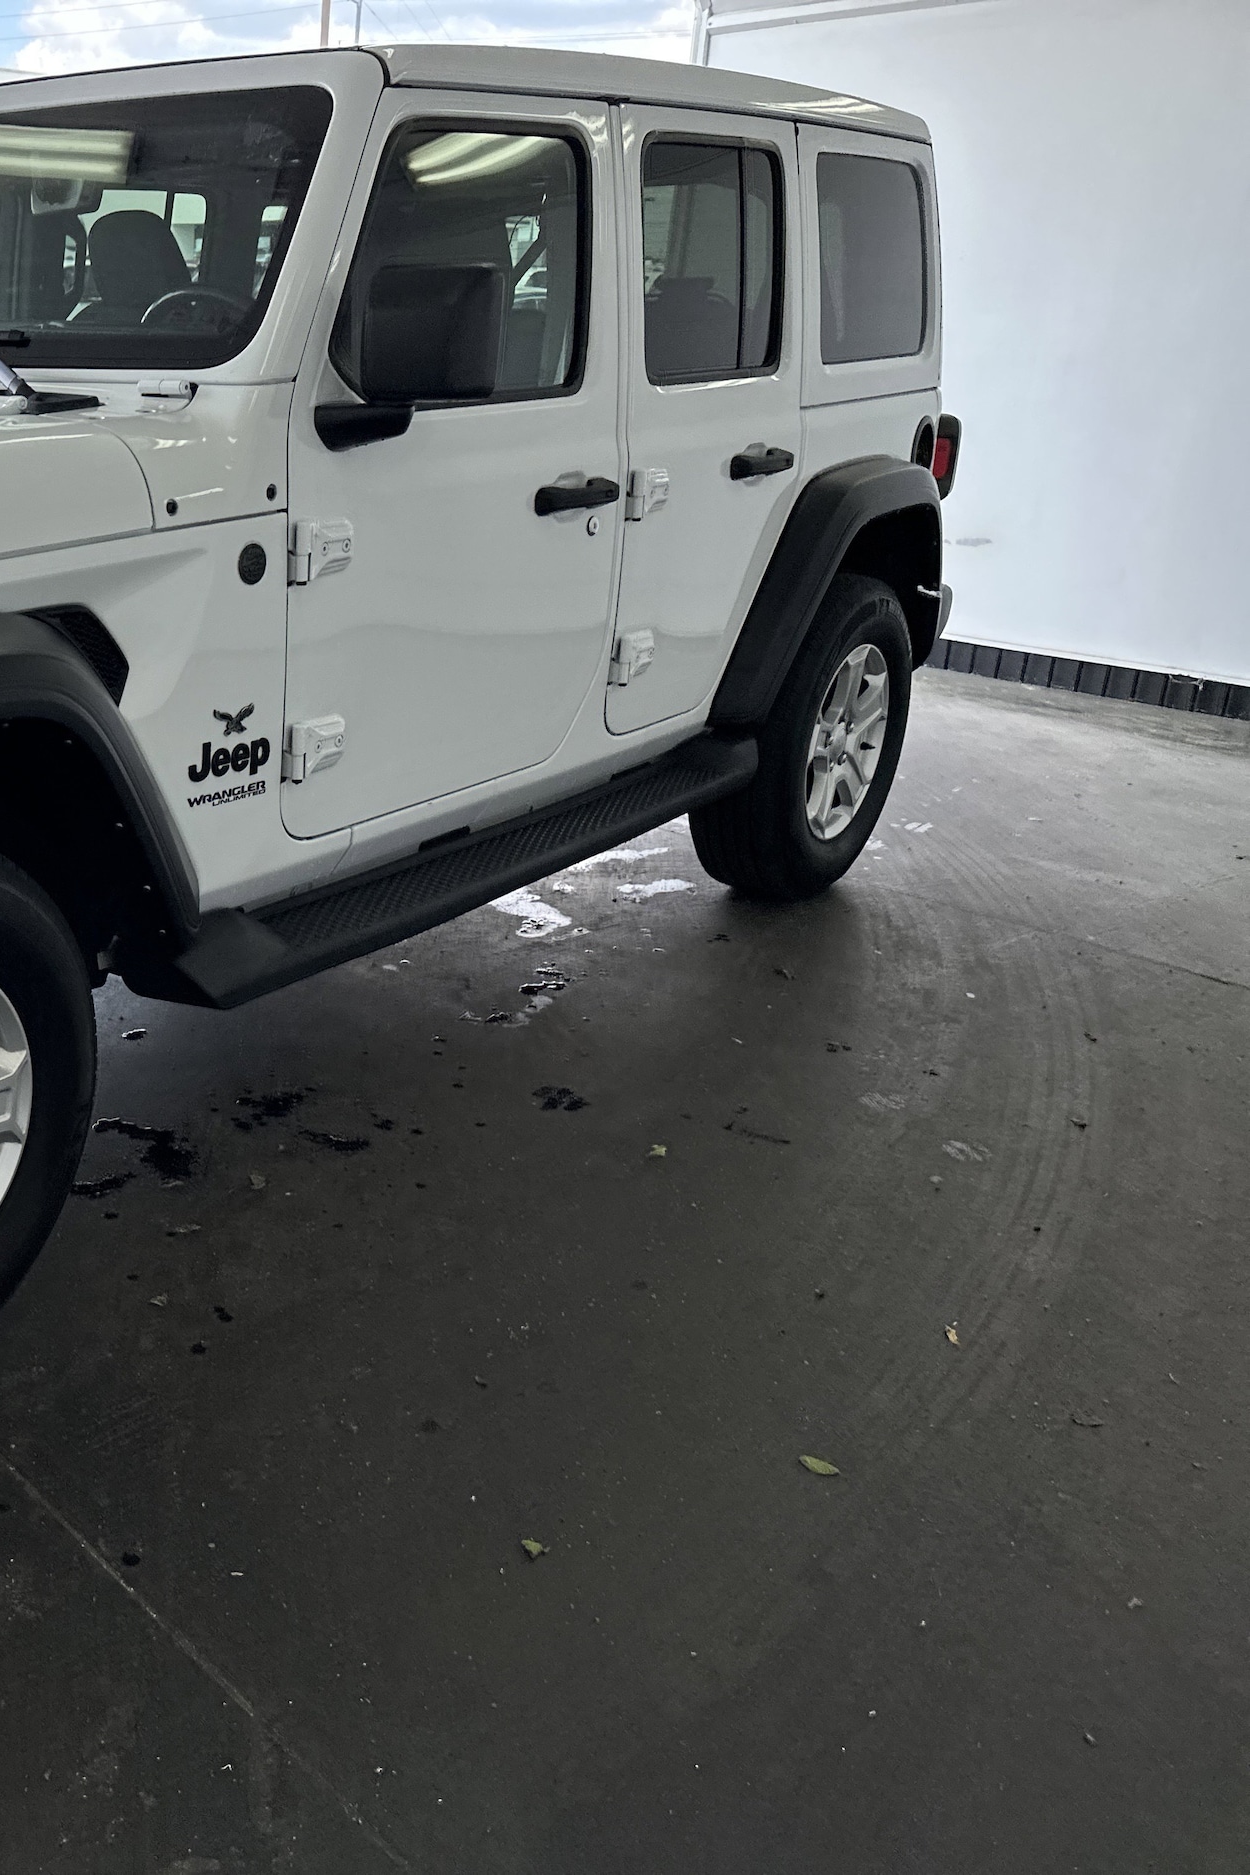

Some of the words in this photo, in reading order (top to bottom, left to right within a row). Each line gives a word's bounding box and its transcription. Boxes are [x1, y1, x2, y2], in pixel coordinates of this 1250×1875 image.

[188, 737, 270, 782] Jeep
[187, 781, 266, 807] WRANGLER
[212, 788, 266, 806] UNLIMITED
